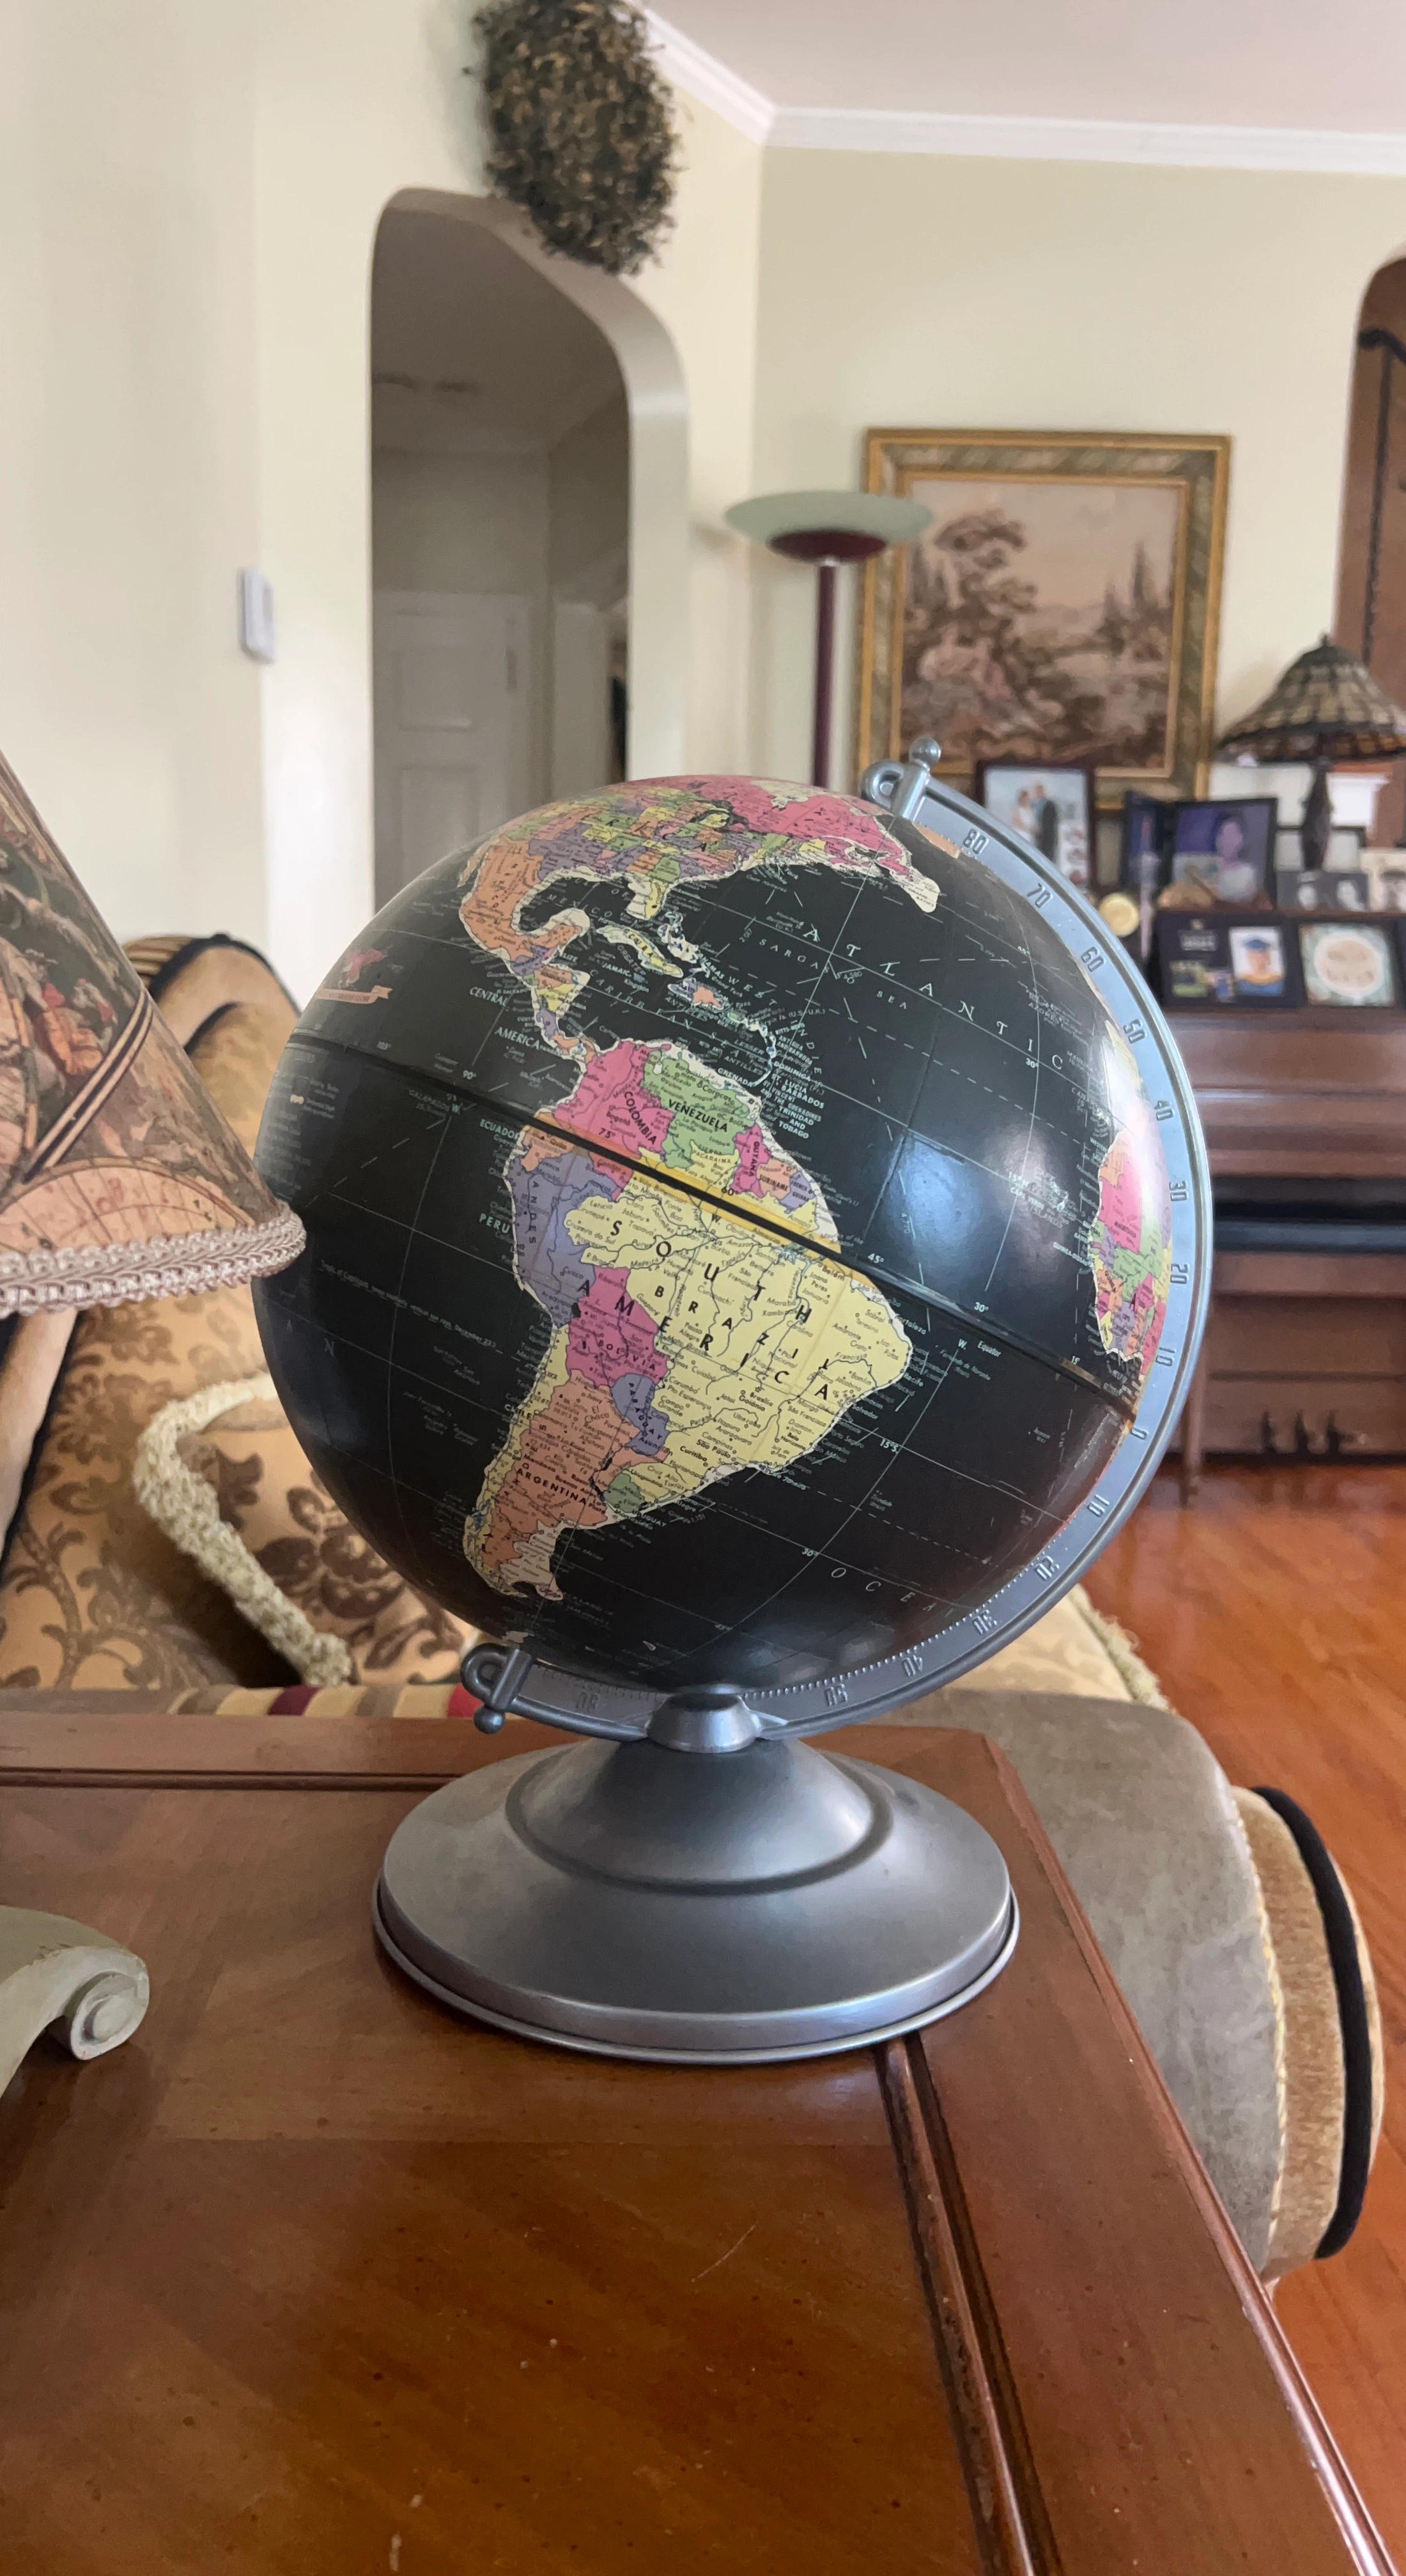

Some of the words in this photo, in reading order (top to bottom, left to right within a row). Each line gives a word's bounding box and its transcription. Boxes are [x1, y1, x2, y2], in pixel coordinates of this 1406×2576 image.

[962, 829, 990, 855] 80
[1026, 882, 1054, 910] 70
[1081, 946, 1108, 972] 60
[469, 986, 508, 1007] CENTRAL
[495, 1027, 540, 1050] AMERICA
[1123, 1018, 1148, 1044] 50
[774, 1061, 812, 1082] DOMINICA
[781, 1086, 825, 1109] BARBADOS
[784, 1079, 808, 1094] LUCIA
[624, 1091, 658, 1144] COLOMBIA
[668, 1098, 728, 1133] VENEZUELA
[778, 1105, 814, 1126] TRINIDAD
[1154, 1100, 1175, 1121] 40
[778, 1121, 810, 1139] TOBAGO
[789, 1118, 806, 1130] AND
[748, 1141, 760, 1177] GUYANA
[1168, 1180, 1189, 1202] 30
[479, 1214, 510, 1234] PERU
[529, 1181, 539, 1245] ANDES
[868, 1254, 885, 1264] 45°
[610, 1220, 812, 1324] SOUTH
[1170, 1263, 1190, 1284] 20
[973, 1301, 989, 1312] 30°
[654, 1285, 830, 1370] BRAZIL
[577, 1279, 828, 1401] AMERICA
[977, 1340, 1002, 1358] Equator
[1155, 1346, 1177, 1367] 10
[585, 1412, 610, 1424] Chaco
[1131, 1425, 1150, 1441] 0
[679, 1445, 708, 1462] Curitiba
[516, 1468, 587, 1506] ARGENTINA
[1087, 1493, 1111, 1518] 10
[1035, 1555, 1061, 1581] 20
[901, 1654, 924, 1678] 40
